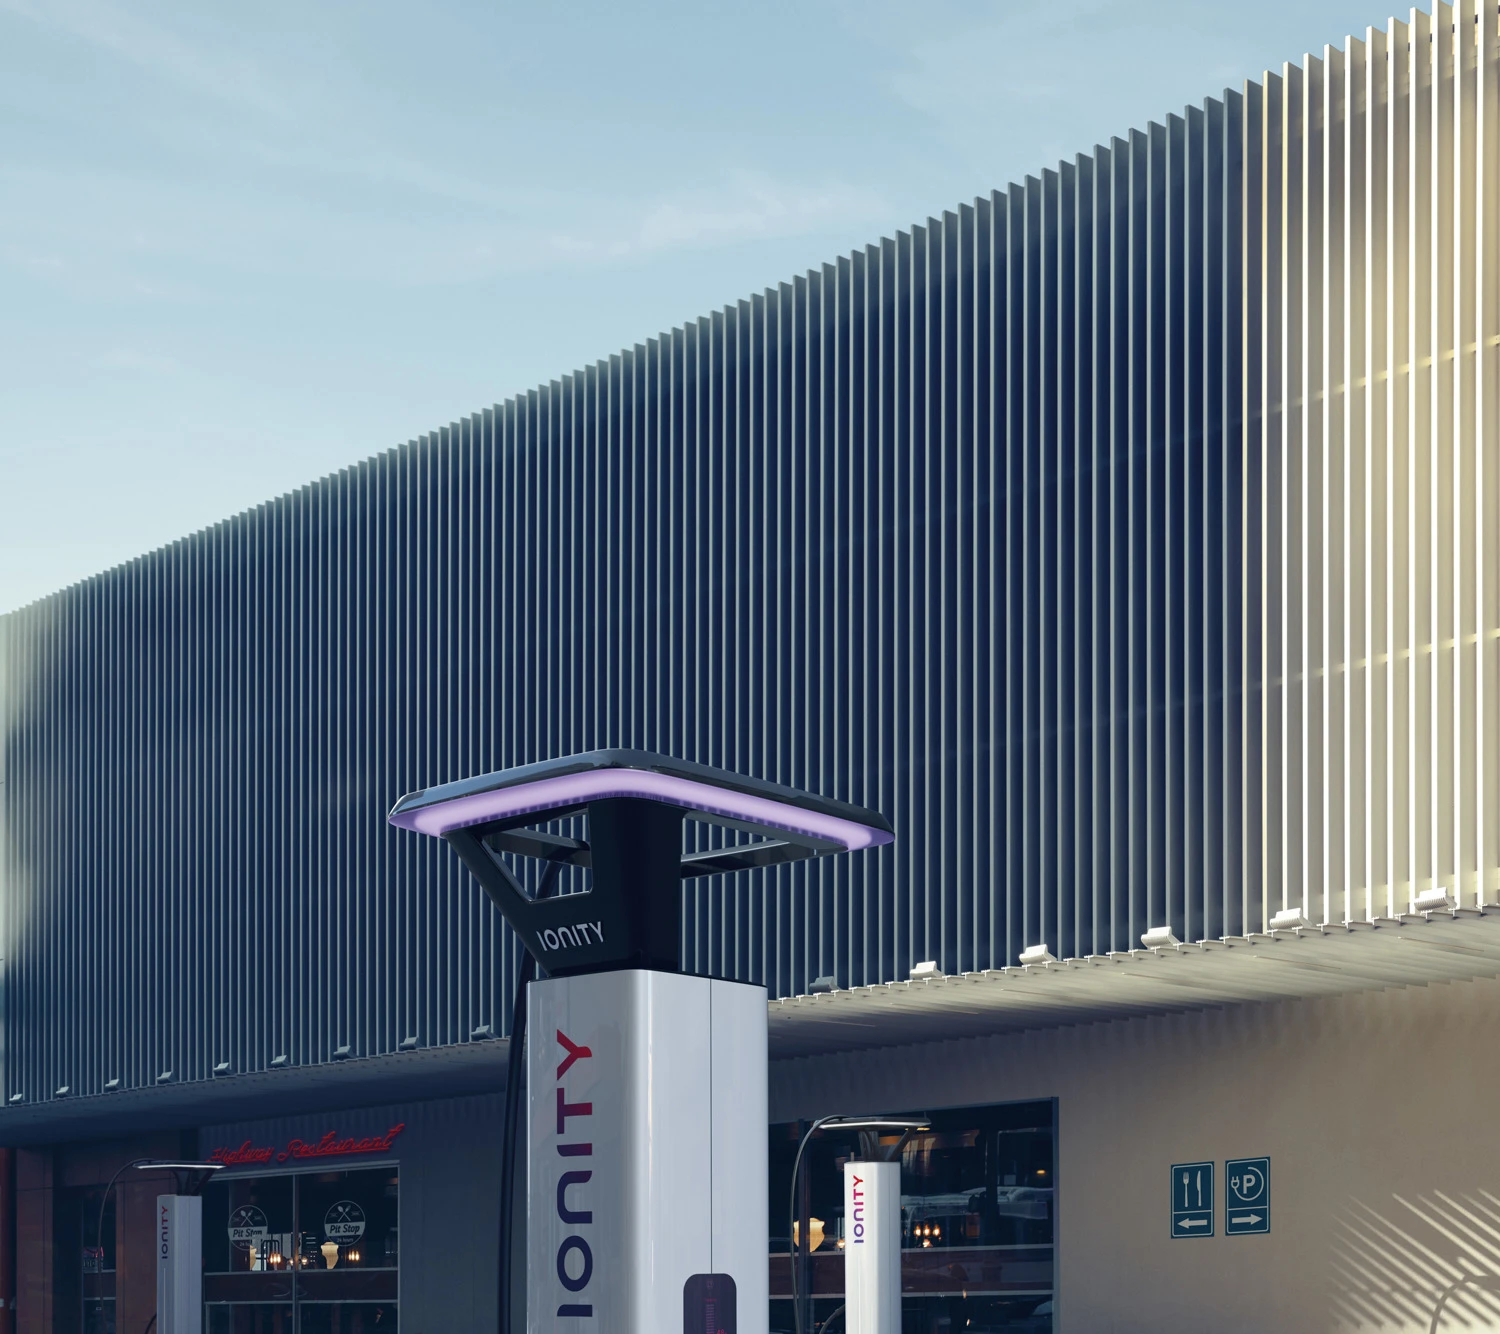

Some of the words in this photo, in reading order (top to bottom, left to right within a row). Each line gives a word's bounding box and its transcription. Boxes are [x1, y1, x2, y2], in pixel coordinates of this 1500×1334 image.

[536, 921, 604, 952] IONITY
[206, 1140, 275, 1165] Highway
[277, 1123, 405, 1162] Restaurant
[556, 1028, 594, 1317] IONITY
[1243, 1175, 1256, 1194] P
[853, 1175, 864, 1243] IONITY
[161, 1205, 169, 1260] IONITY
[233, 1229, 244, 1238] Pit
[329, 1225, 341, 1234] Pit
[343, 1224, 360, 1235] Stop
